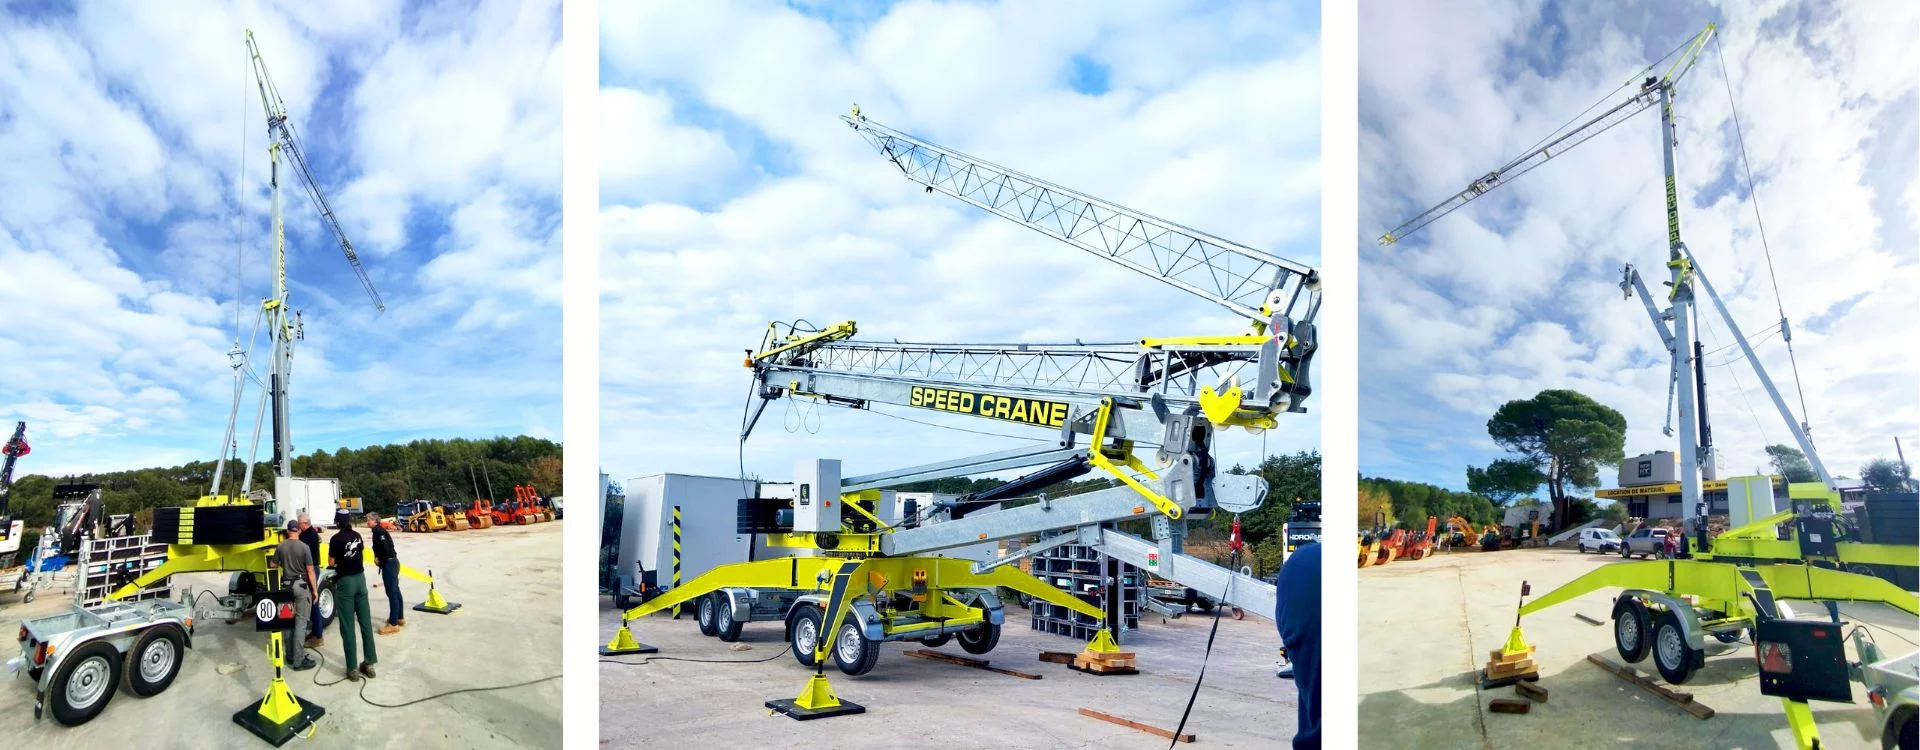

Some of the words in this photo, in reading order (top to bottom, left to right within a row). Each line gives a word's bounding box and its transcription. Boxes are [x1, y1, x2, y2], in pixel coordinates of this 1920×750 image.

[1666, 175, 1677, 209] CRANE
[1669, 210, 1680, 248] SPEED
[911, 387, 974, 413] SPEED
[980, 395, 1068, 427] CRANE
[1608, 488, 1630, 496] LOCATION
[260, 602, 273, 618] 80
